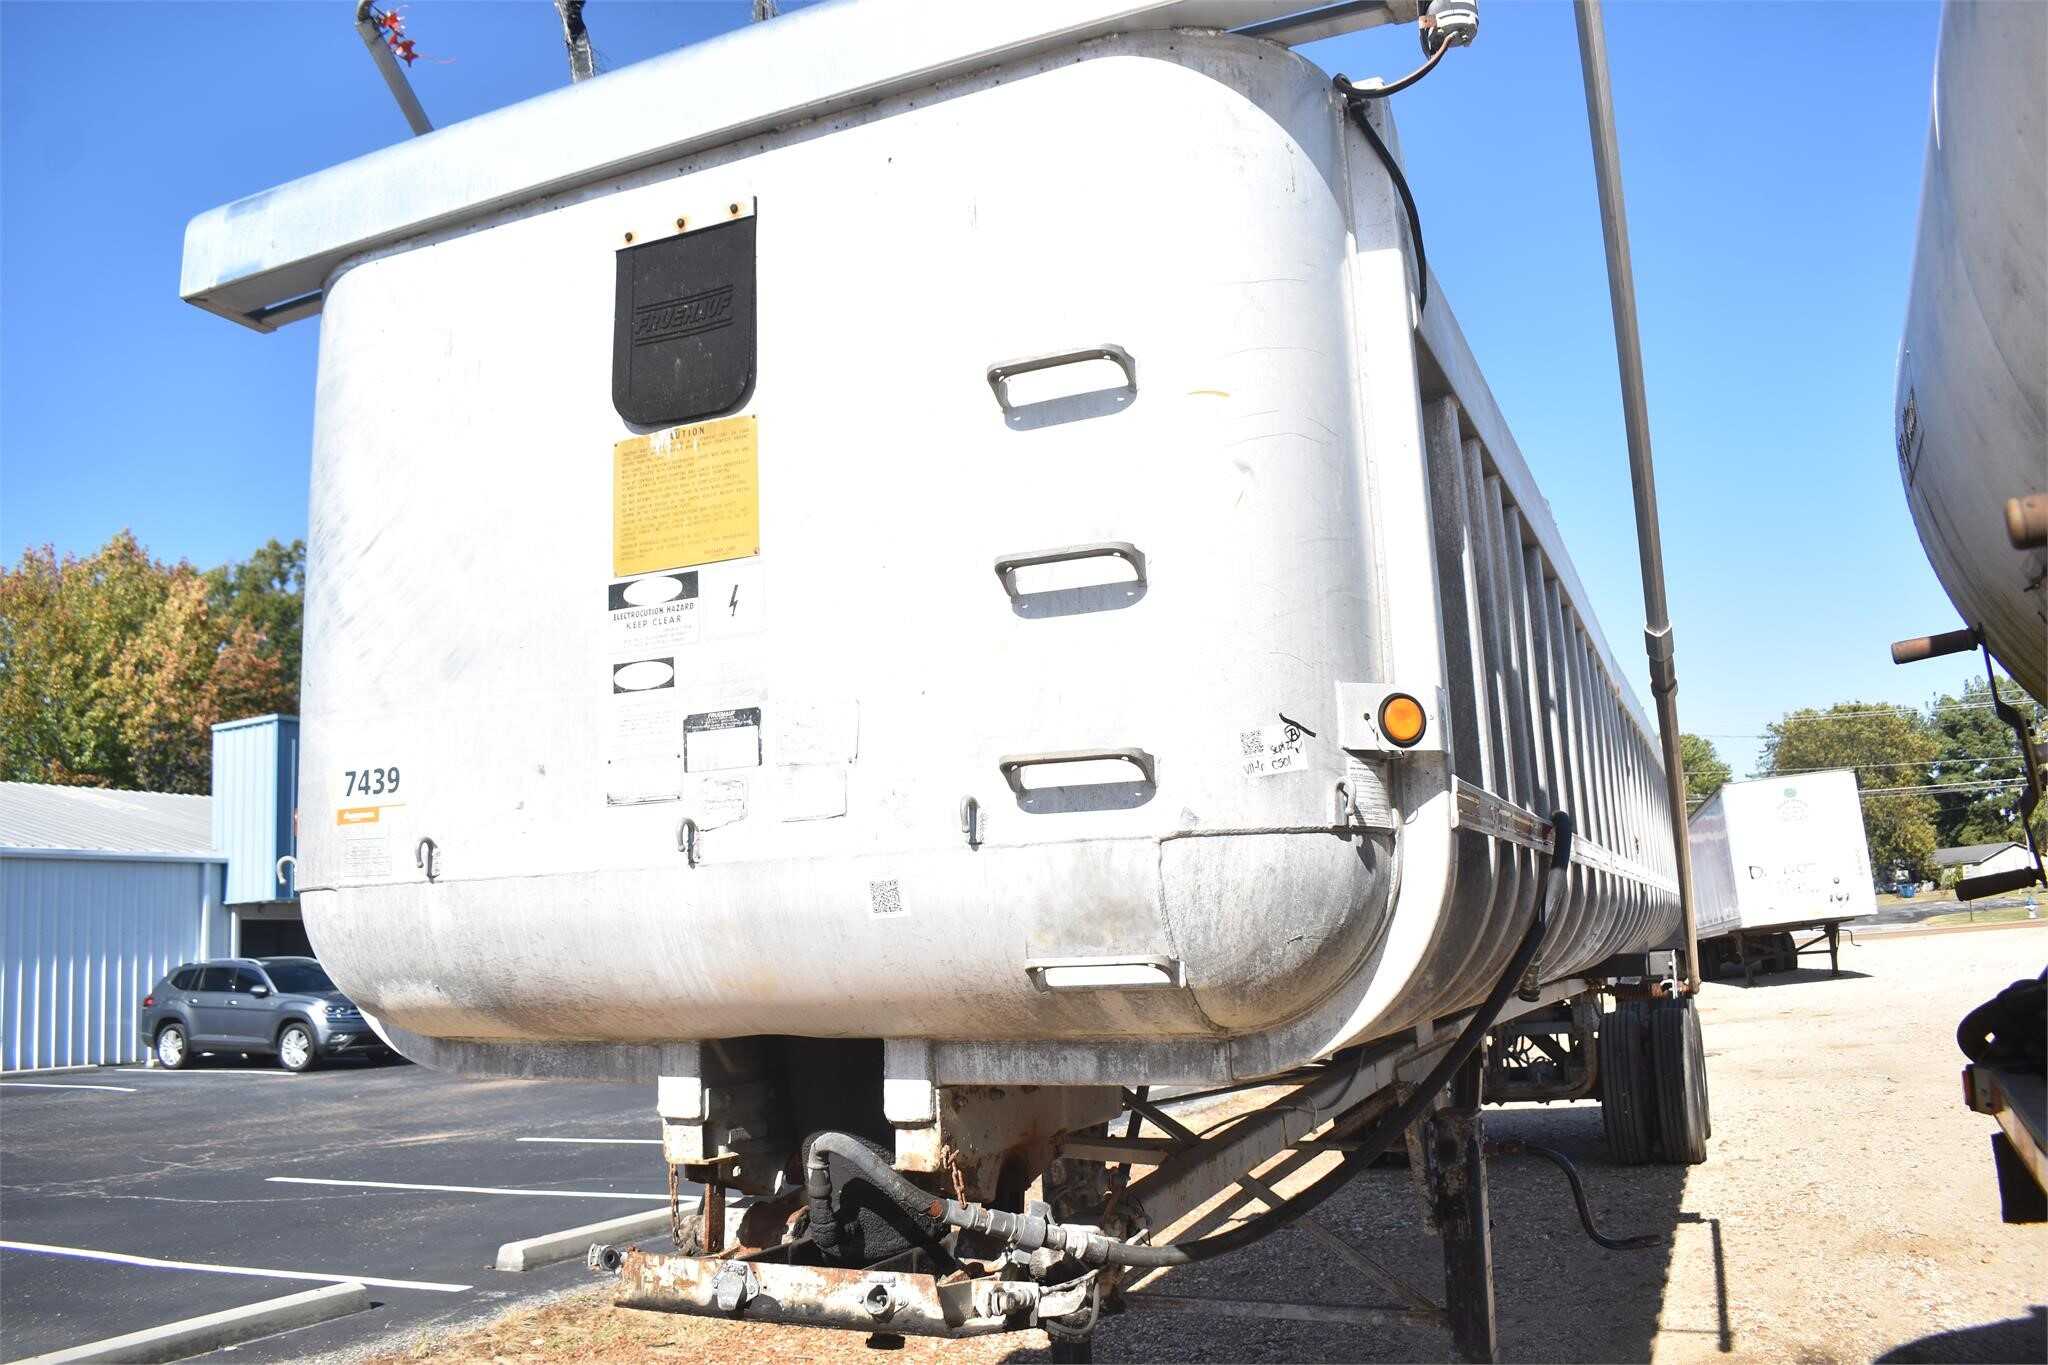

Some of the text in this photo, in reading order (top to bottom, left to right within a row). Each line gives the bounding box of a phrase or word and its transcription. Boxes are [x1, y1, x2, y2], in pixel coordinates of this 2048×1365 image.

[665, 427, 705, 440] AUTION
[613, 603, 694, 621] ELECTROCUTION HAZARD
[627, 616, 681, 630] KEEP CLEAR
[345, 766, 400, 796] 7439
